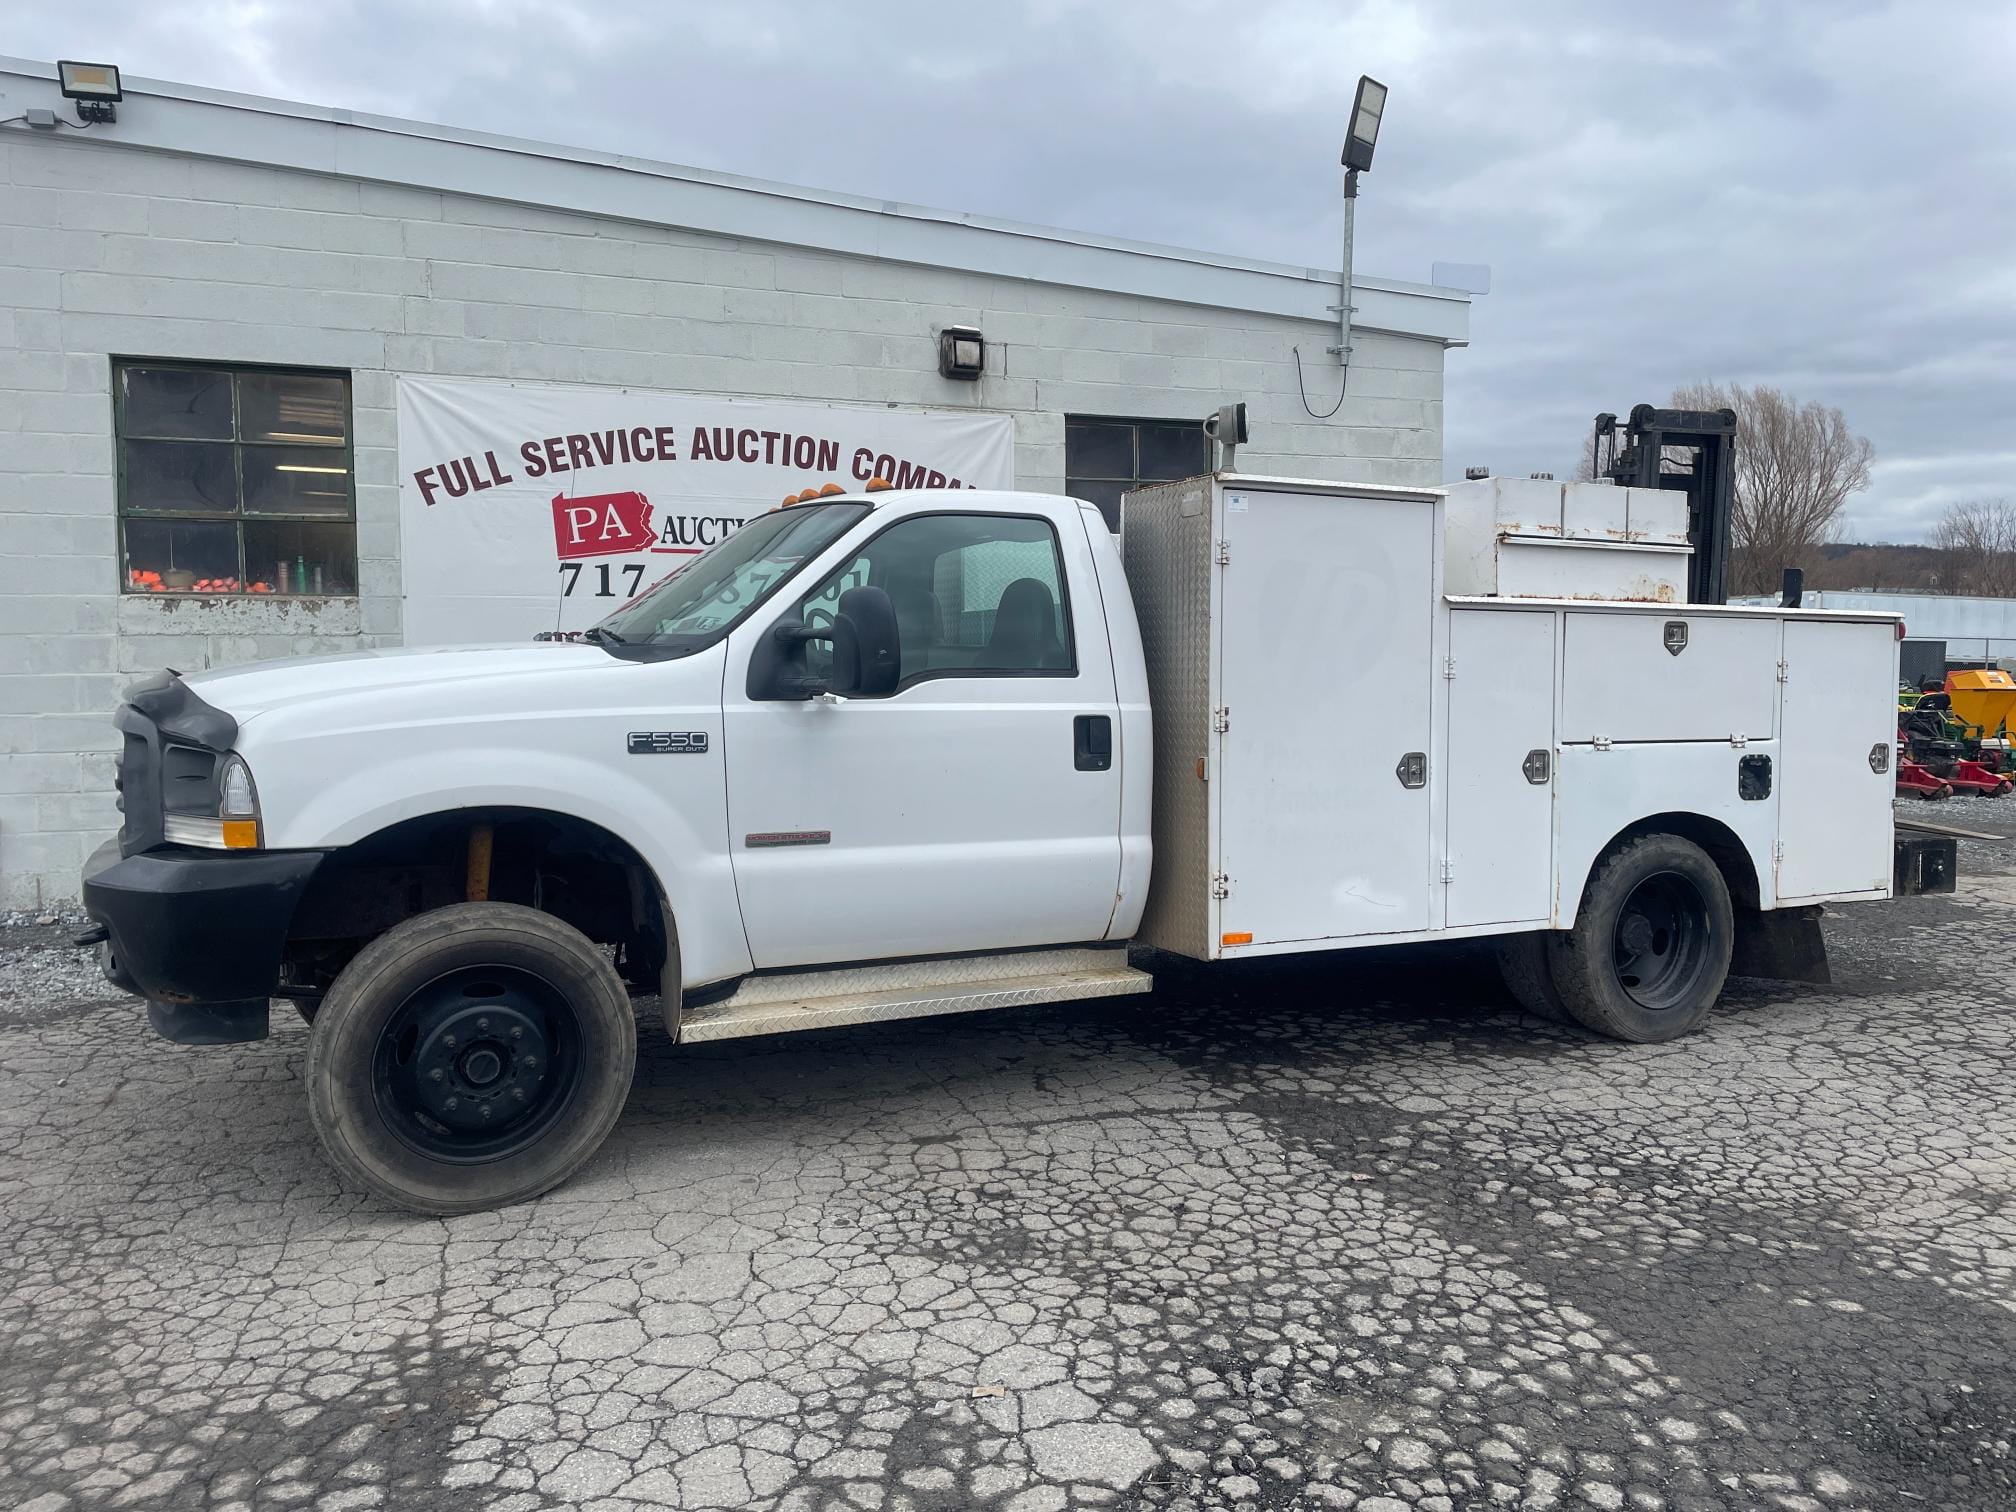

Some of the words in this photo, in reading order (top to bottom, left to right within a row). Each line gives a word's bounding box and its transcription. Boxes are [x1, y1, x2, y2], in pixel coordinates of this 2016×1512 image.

[414, 451, 513, 506] FULL
[520, 426, 677, 478] SERVICE
[690, 427, 839, 471] AUCTION
[851, 448, 977, 490] COMP
[564, 503, 632, 544] PA
[558, 562, 646, 597] 717
